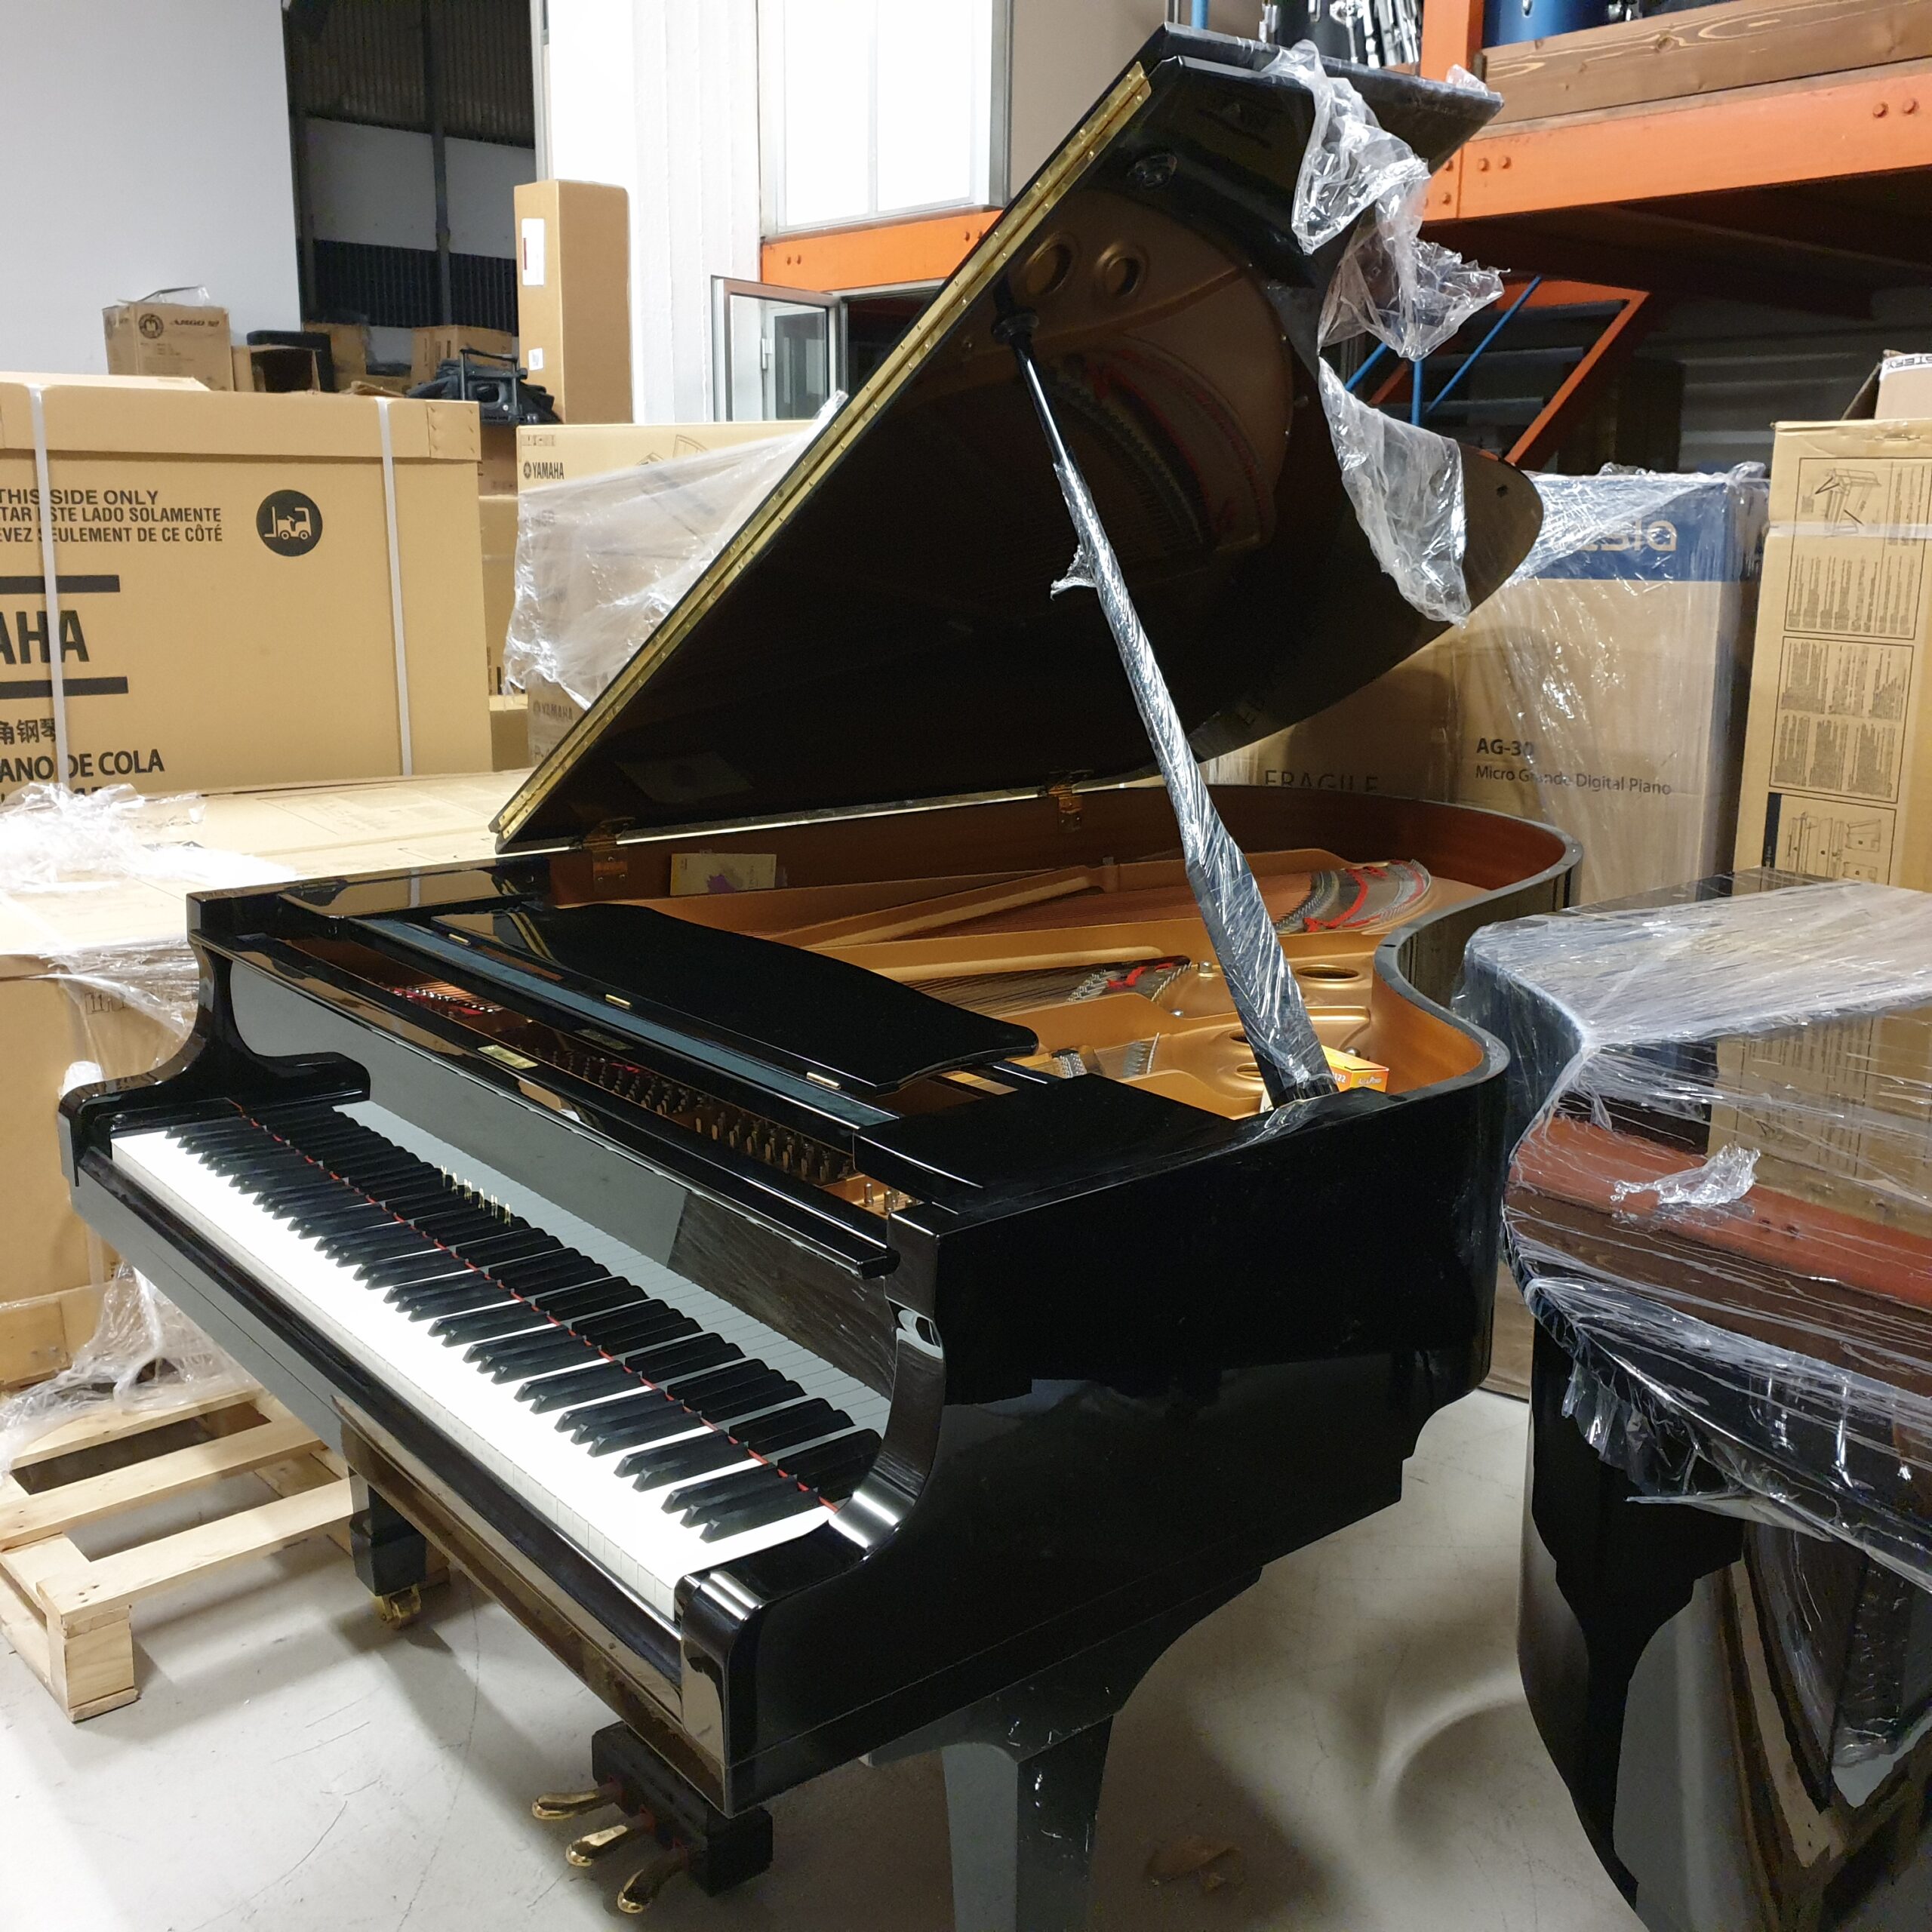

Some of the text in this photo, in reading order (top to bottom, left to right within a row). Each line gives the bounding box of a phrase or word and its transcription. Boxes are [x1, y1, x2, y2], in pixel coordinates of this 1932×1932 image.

[533, 462, 565, 479] YAMAHA
[50, 489, 98, 505] SIDE
[103, 490, 158, 505] ONLY
[38, 506, 78, 521] STE
[82, 507, 124, 522] LADO
[129, 507, 222, 522] SOLAMENTE
[0, 527, 33, 542] VEZ
[137, 527, 157, 542] DE
[162, 527, 180, 542] CE
[185, 524, 223, 542] CÔTÉ
[67, 753, 94, 778] DE
[98, 749, 165, 775] COLA
[1475, 765, 1515, 782] Micro
[1576, 773, 1625, 792] Digital
[1629, 777, 1672, 795] Piano
